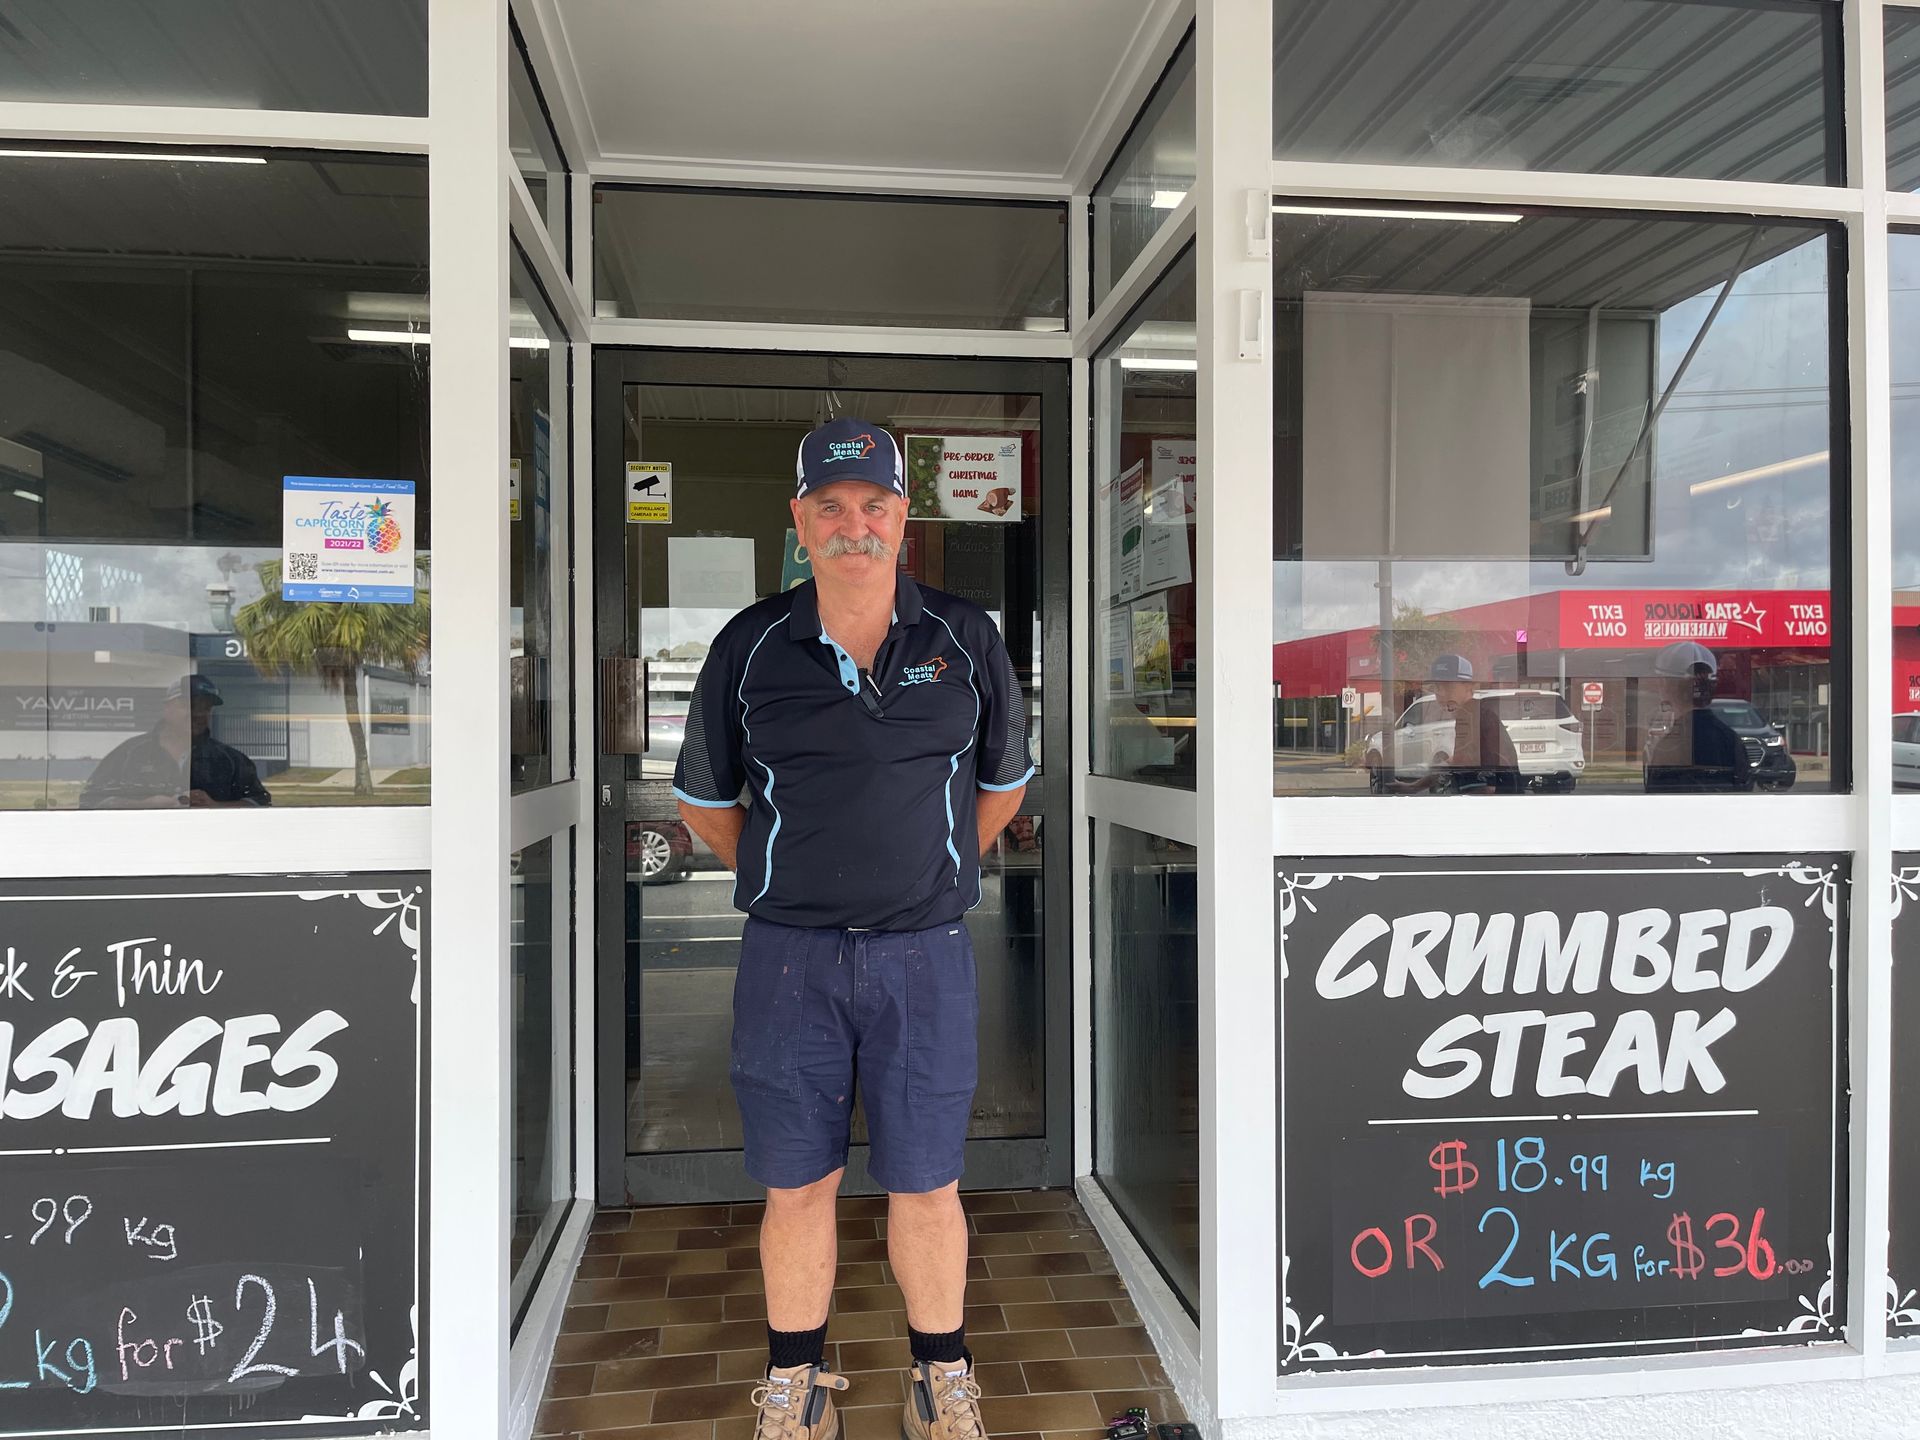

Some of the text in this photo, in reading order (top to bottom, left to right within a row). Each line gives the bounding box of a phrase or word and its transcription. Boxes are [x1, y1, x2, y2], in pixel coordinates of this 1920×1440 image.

[829, 442, 864, 450] Coastal
[943, 452, 995, 462] PRE-ORDER
[949, 471, 998, 481] CHRISTMAS
[320, 501, 367, 520] Taste
[295, 518, 365, 528] CAPRICORN
[324, 527, 365, 538] COAST
[330, 540, 361, 548] 2021/22
[903, 665, 936, 674] Coastal
[907, 672, 933, 680] Meats
[1314, 906, 1795, 1000] CRUMBED
[51, 947, 98, 999] &
[107, 938, 223, 1007] Thin
[1402, 1007, 1737, 1098] STEAK
[0, 1010, 350, 1120] SAGES
[1351, 1214, 1446, 1279] OR
[116, 1306, 186, 1380] for
